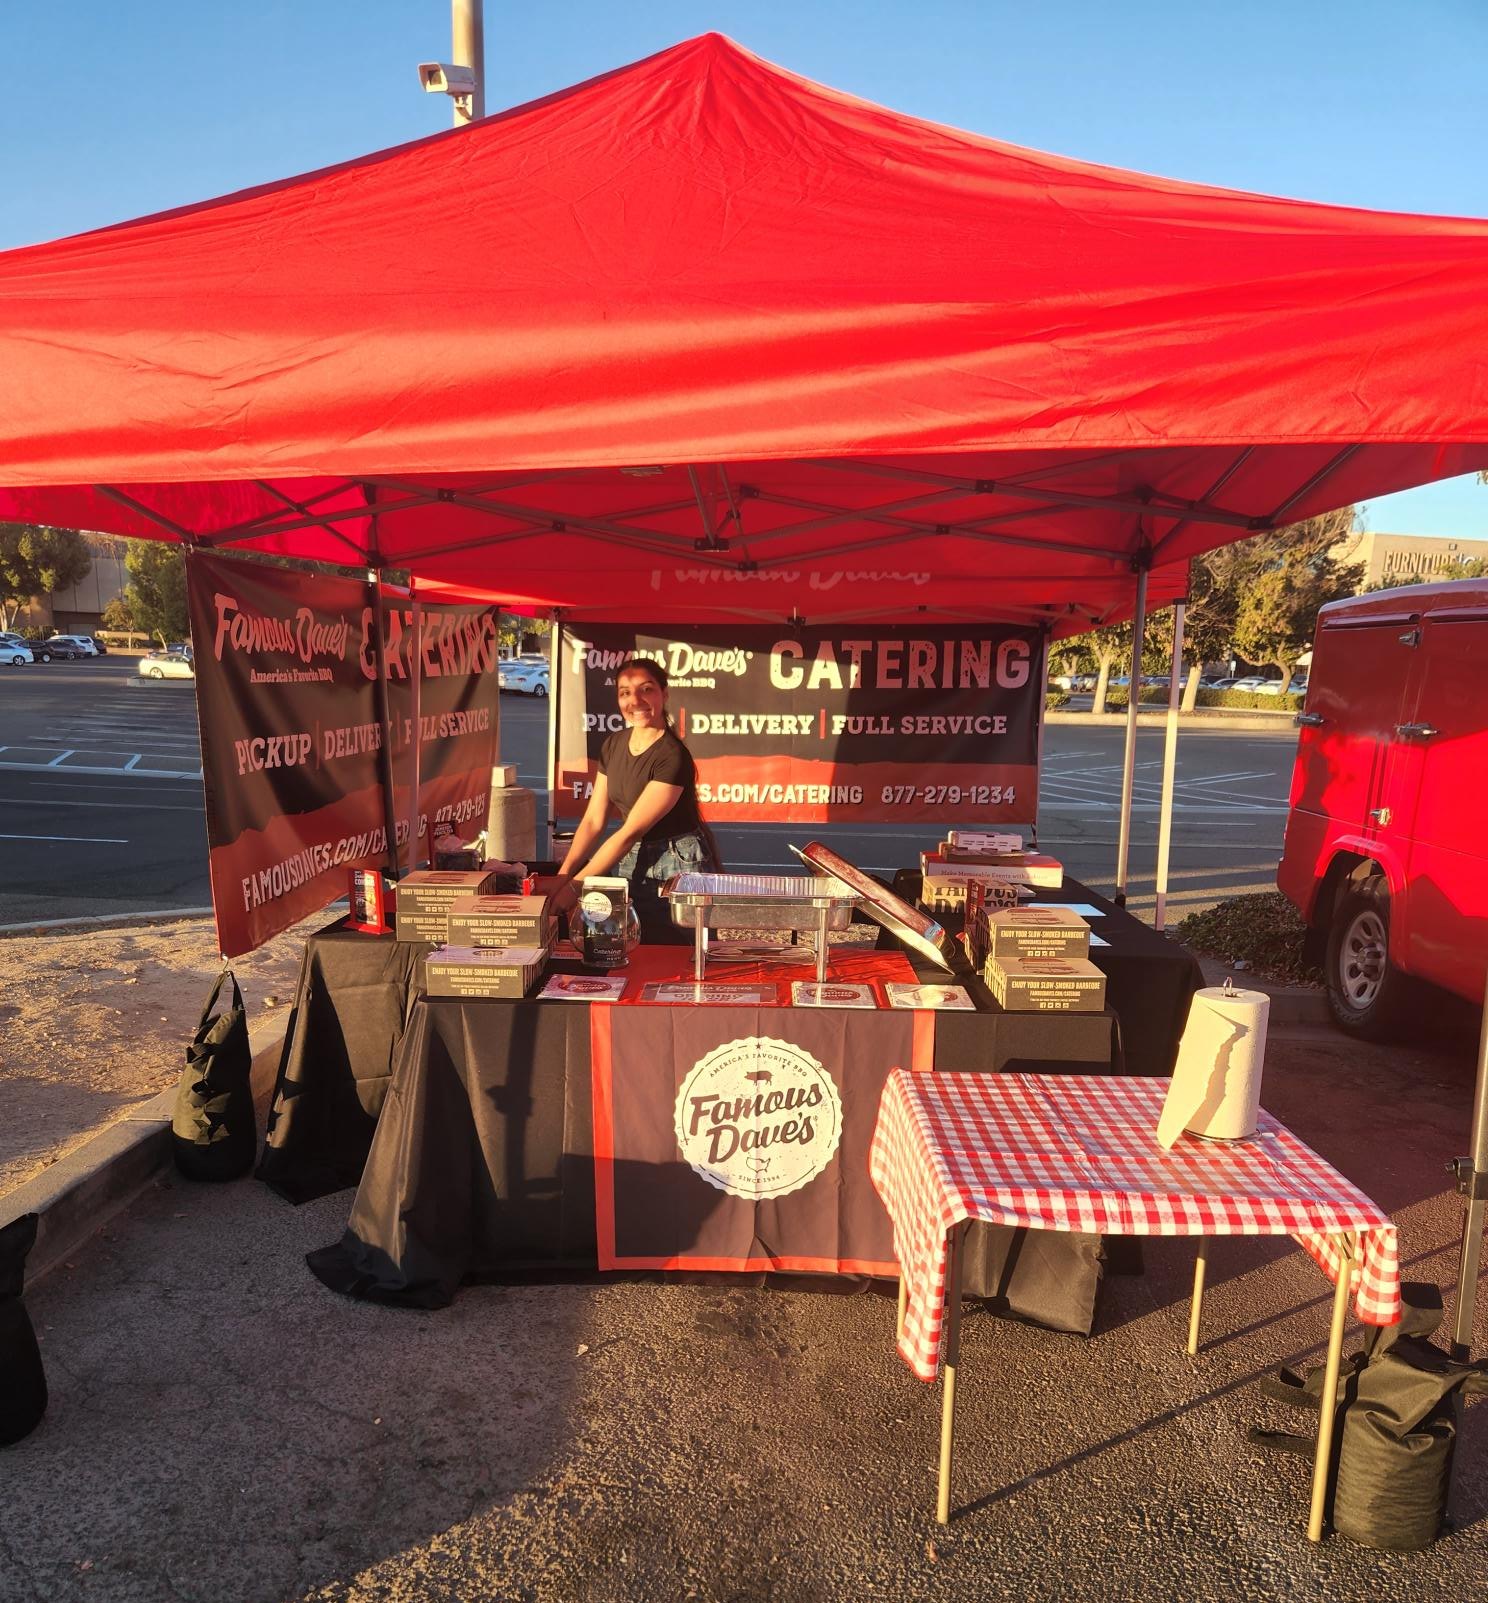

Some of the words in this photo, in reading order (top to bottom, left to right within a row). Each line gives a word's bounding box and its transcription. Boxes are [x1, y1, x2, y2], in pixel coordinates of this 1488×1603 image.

[215, 592, 295, 661] Famous
[295, 607, 348, 663] Dave's
[668, 642, 747, 676] Dave's
[769, 639, 1030, 690] CATERING
[250, 668, 292, 683] America's
[692, 678, 716, 689] BBQ
[691, 714, 814, 734] DELIVERY
[832, 715, 895, 735] FULL
[901, 715, 1007, 735] SERVICE
[235, 733, 312, 775] PICKUP
[439, 708, 489, 738] SERVICE
[882, 785, 1015, 804] 877-279-1234
[452, 918, 466, 926] ENJOY
[1000, 930, 1014, 938] ENJOY
[1015, 930, 1028, 938] YOUR
[432, 967, 446, 975] ENJOY
[1011, 981, 1026, 989] ENJOY
[1027, 981, 1040, 989] YOUR
[1040, 981, 1075, 990] SLOW-SMOKED
[709, 1054, 749, 1077] AMERICA'S
[753, 1053, 792, 1066] FAVORITE
[793, 1064, 807, 1077] BBQ
[689, 1083, 823, 1136] Famous
[705, 1111, 815, 1164] Dave's
[738, 1175, 761, 1183] SINCE
[763, 1175, 780, 1183] 1994
